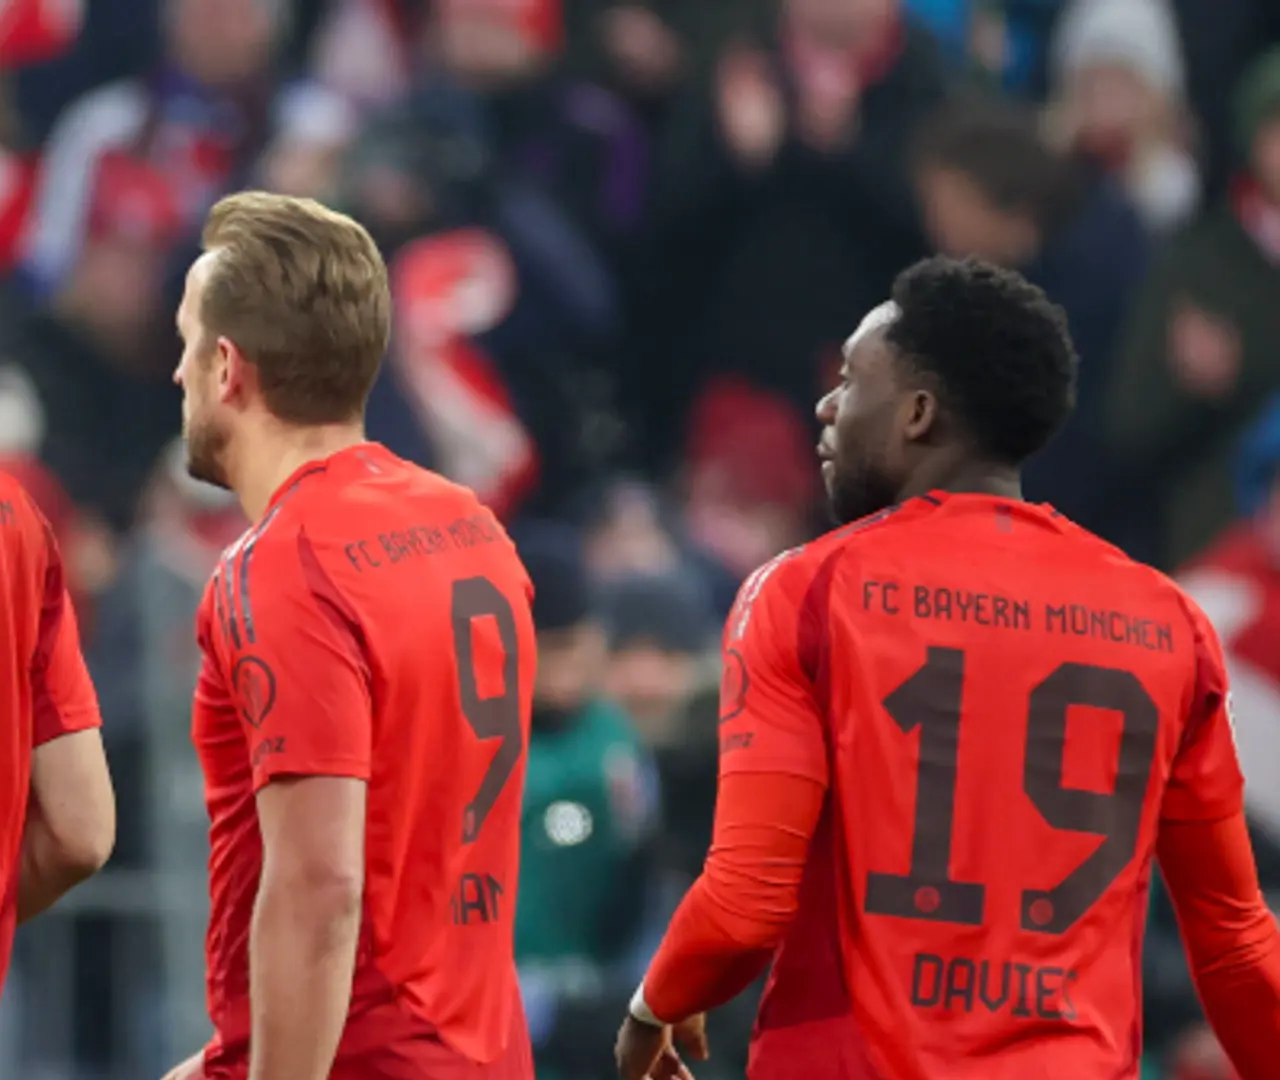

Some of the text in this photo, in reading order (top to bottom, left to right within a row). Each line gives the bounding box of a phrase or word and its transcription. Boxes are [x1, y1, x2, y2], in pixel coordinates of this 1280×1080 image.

[344, 539, 381, 573] FC
[863, 581, 900, 615] FC
[913, 585, 1031, 631] BAYERN
[451, 575, 522, 845] 9
[863, 645, 1160, 936] 19
[911, 953, 1079, 1021] DAVIES
